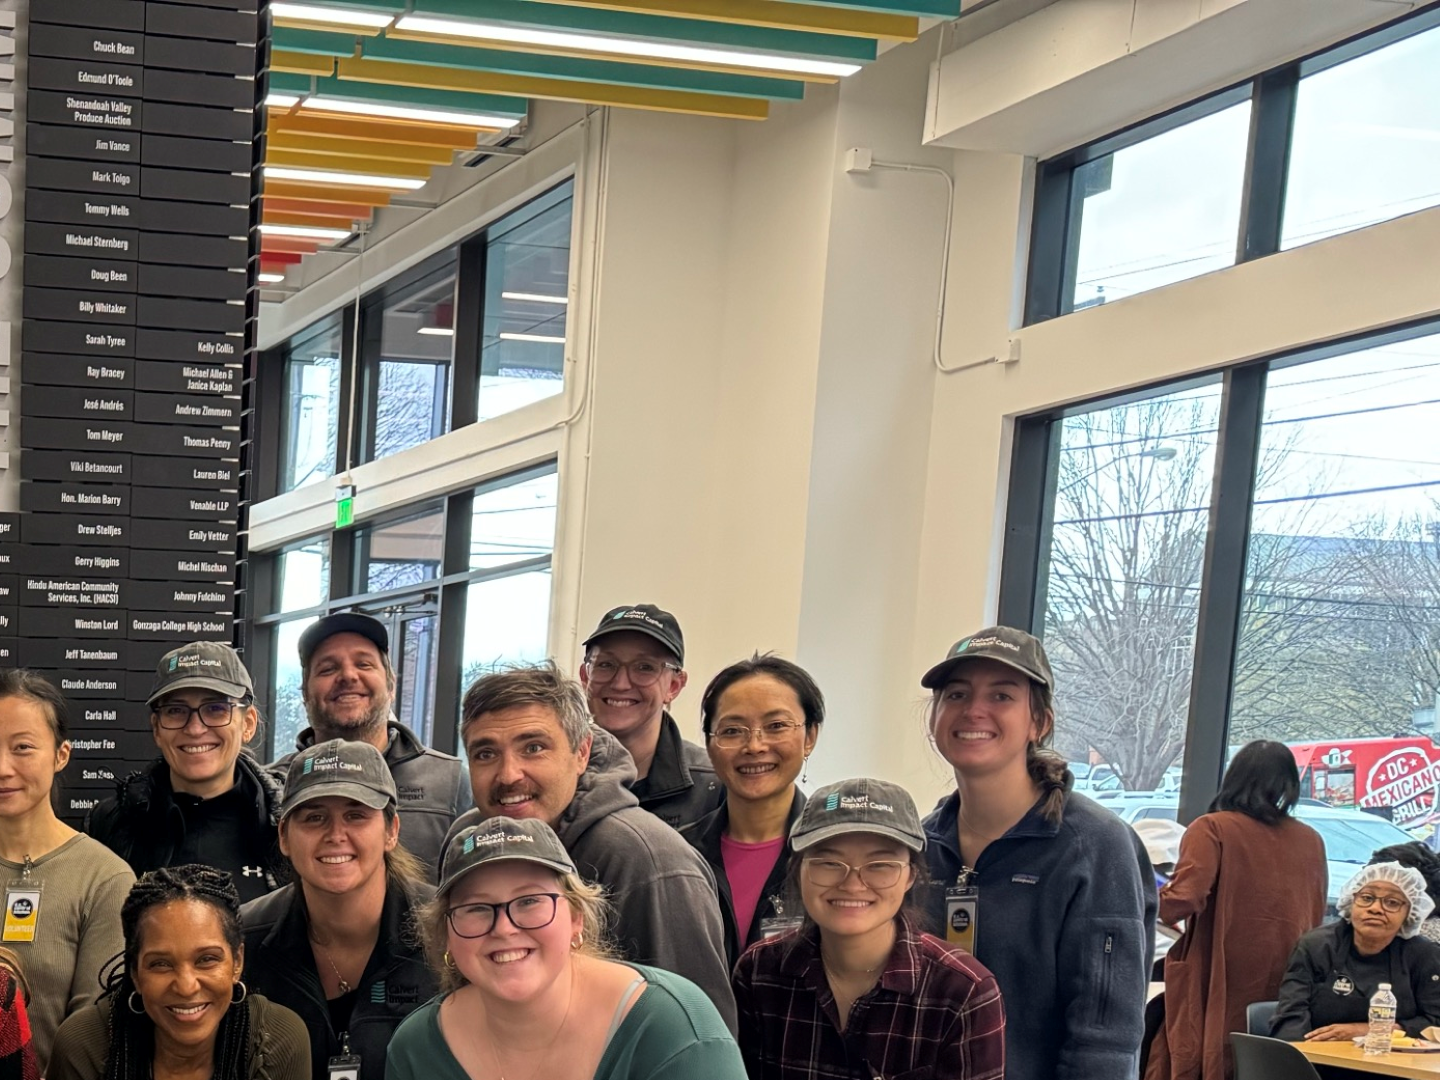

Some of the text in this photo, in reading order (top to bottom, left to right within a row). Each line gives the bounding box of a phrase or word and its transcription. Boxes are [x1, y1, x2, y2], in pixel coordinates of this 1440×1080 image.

[94, 41, 134, 55] Chuck Bean
[78, 71, 107, 84] Edmund
[67, 97, 132, 114] Shenandoah Valley
[75, 111, 131, 125] Produce Auction
[96, 140, 130, 151] Jim Vance
[93, 171, 110, 182] Mark
[85, 203, 129, 216] Tommy Wells
[66, 234, 128, 250] Michael Sternberg
[91, 269, 109, 282] Doug
[80, 301, 126, 314] Billy Whitaker
[86, 334, 125, 347] Sarah Tyree
[198, 342, 234, 354] Kelly Collis
[87, 366, 125, 380] Ray Bracey
[183, 367, 209, 378] Michael
[210, 369, 227, 379] Allen
[187, 380, 232, 392] Janice Kaplan
[175, 404, 231, 416] Andrew Zimmern
[87, 429, 123, 442] Tom Meyer
[184, 436, 231, 450] Thomas Penny
[85, 462, 122, 473] Betancourt
[194, 469, 216, 479] Lauren
[62, 493, 121, 506] Hon. Marion Barry
[190, 500, 229, 511] Venable LLP
[78, 524, 95, 534] Drew
[189, 530, 229, 542] Emily Vetter
[75, 556, 119, 568] Gerry Higgins
[178, 561, 227, 572] Michel Nischan
[28, 580, 119, 593] Hindu American Community
[48, 593, 79, 604] Services,
[81, 594, 92, 602] Inc.
[174, 591, 197, 602] Johnny
[75, 619, 118, 630] Winston Lord
[133, 620, 224, 632] Gonzaga College High School
[65, 650, 79, 659] Jeff
[62, 679, 116, 689] Claude Anderson
[85, 710, 116, 720] Carla Hall
[68, 740, 115, 750] ristopher Fee
[314, 755, 339, 765] Calvert
[314, 762, 362, 771] Impact Capital
[1386, 757, 1409, 780] DC
[83, 770, 96, 779] Sam
[841, 795, 869, 803] Calvert
[869, 802, 893, 813] Capital
